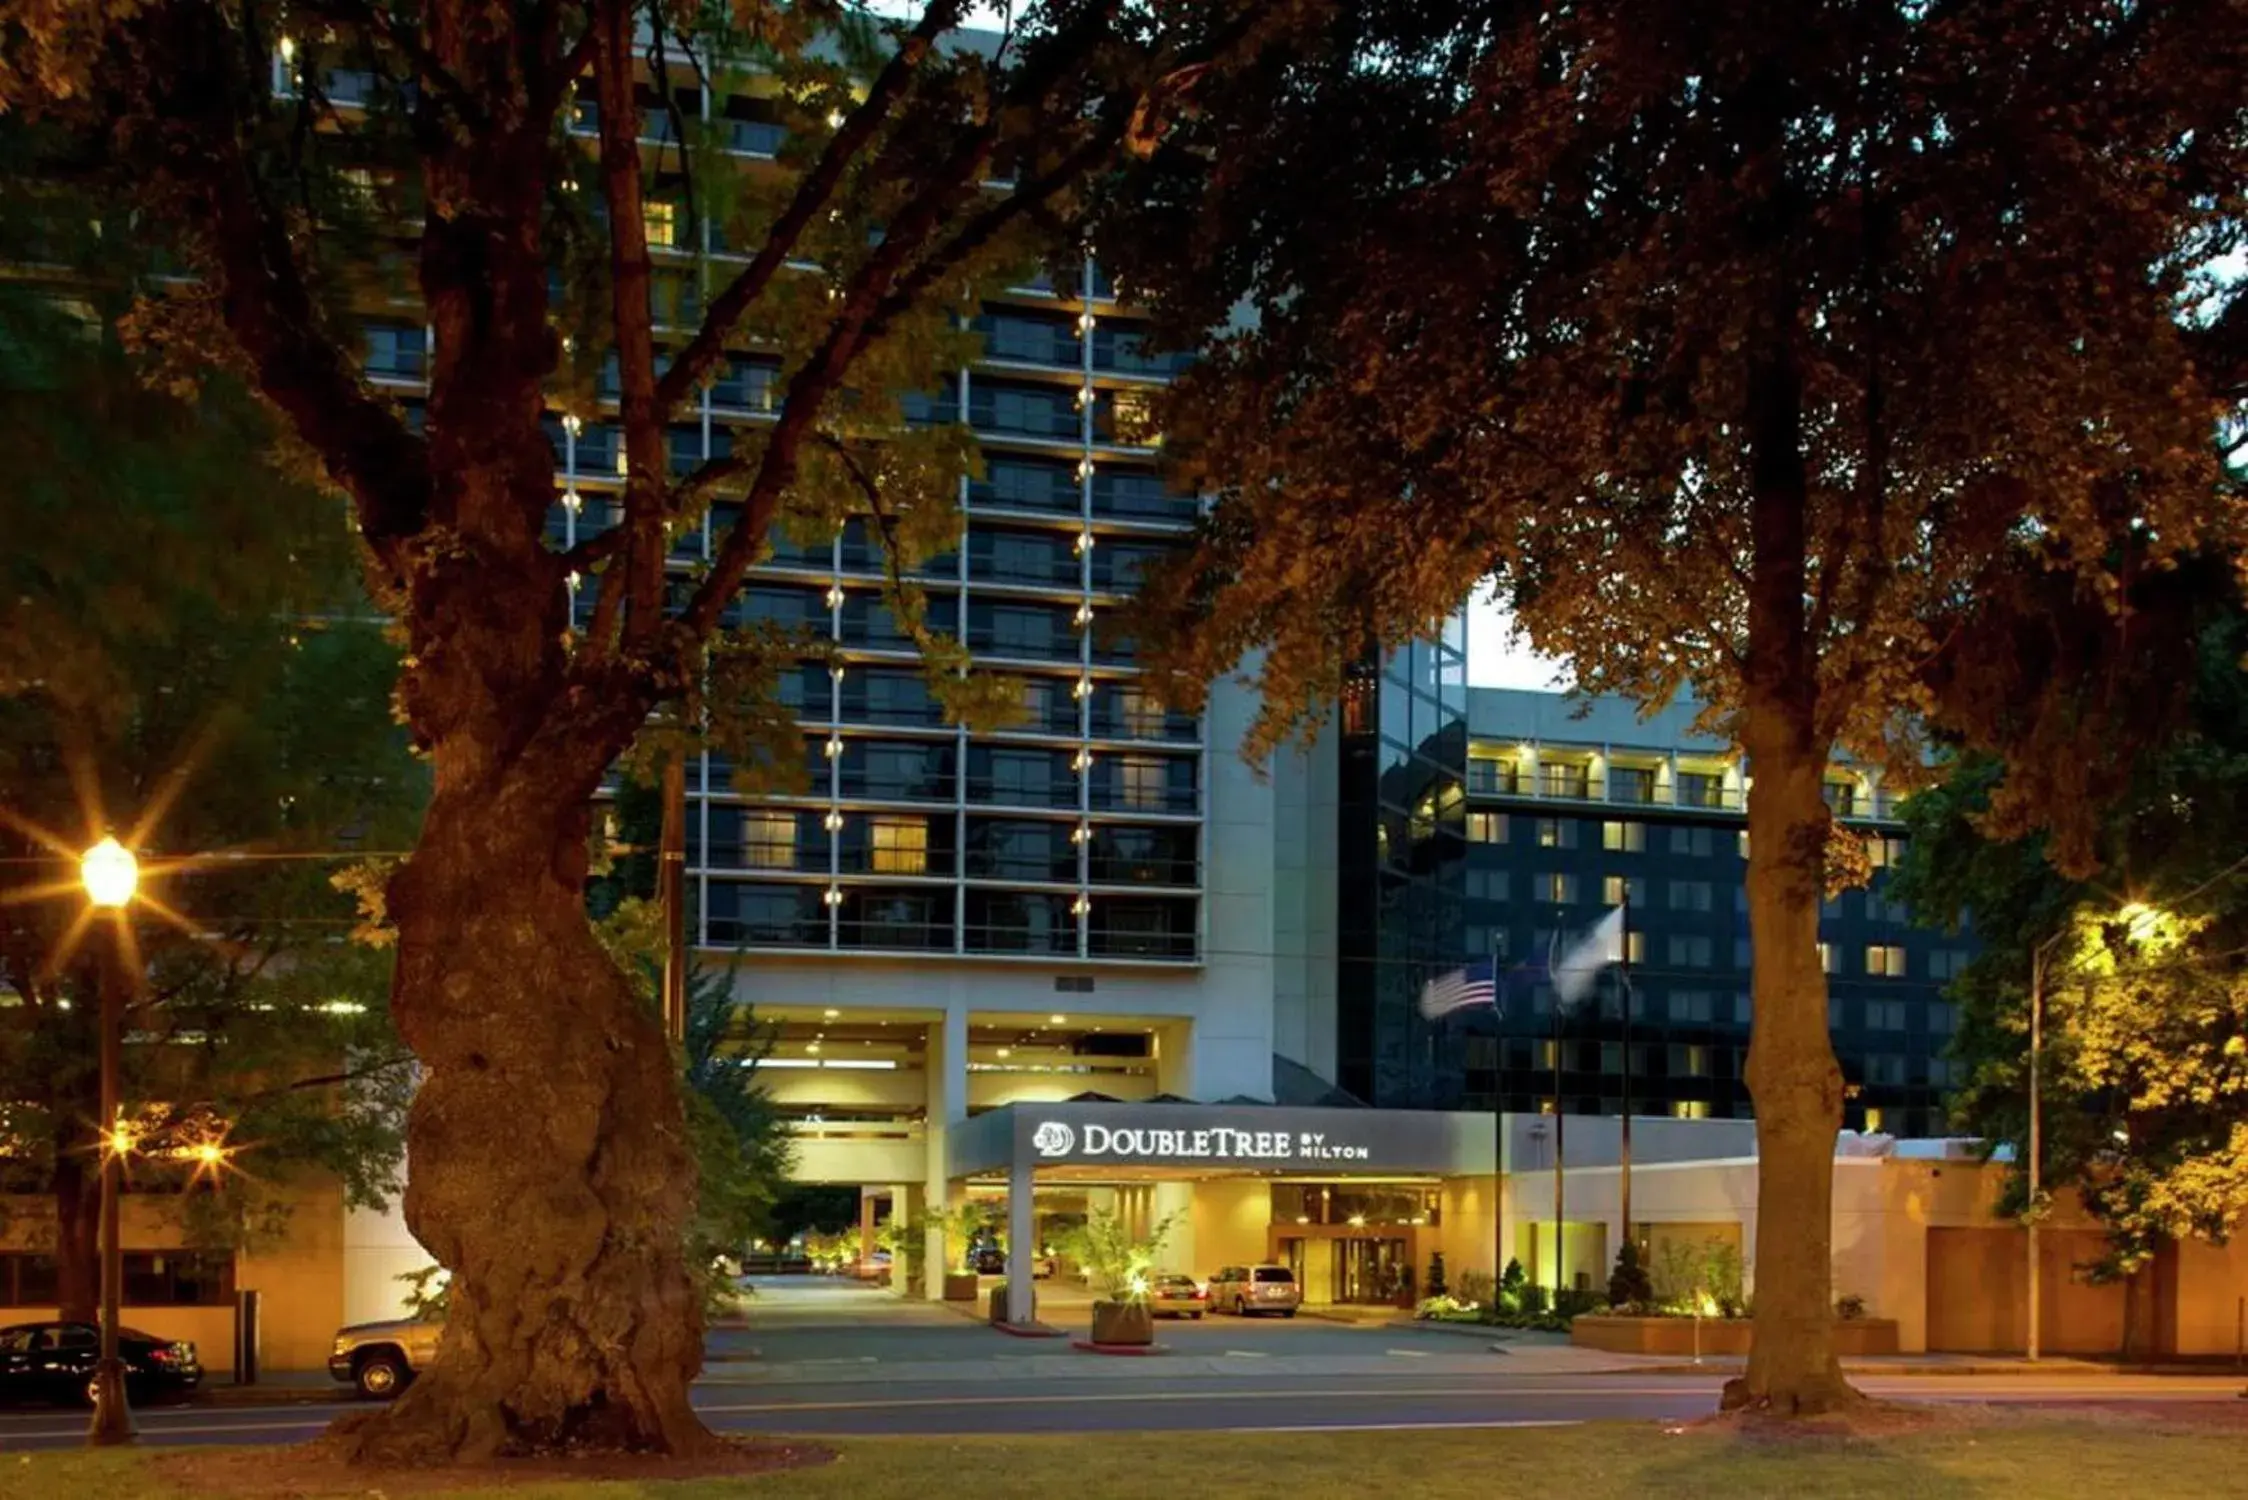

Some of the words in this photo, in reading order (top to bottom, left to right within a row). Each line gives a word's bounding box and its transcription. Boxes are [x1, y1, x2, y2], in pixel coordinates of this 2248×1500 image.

[1083, 1124, 1292, 1158] DOUBLETREE
[1300, 1133, 1325, 1146] BY
[1300, 1146, 1369, 1160] HILTON
